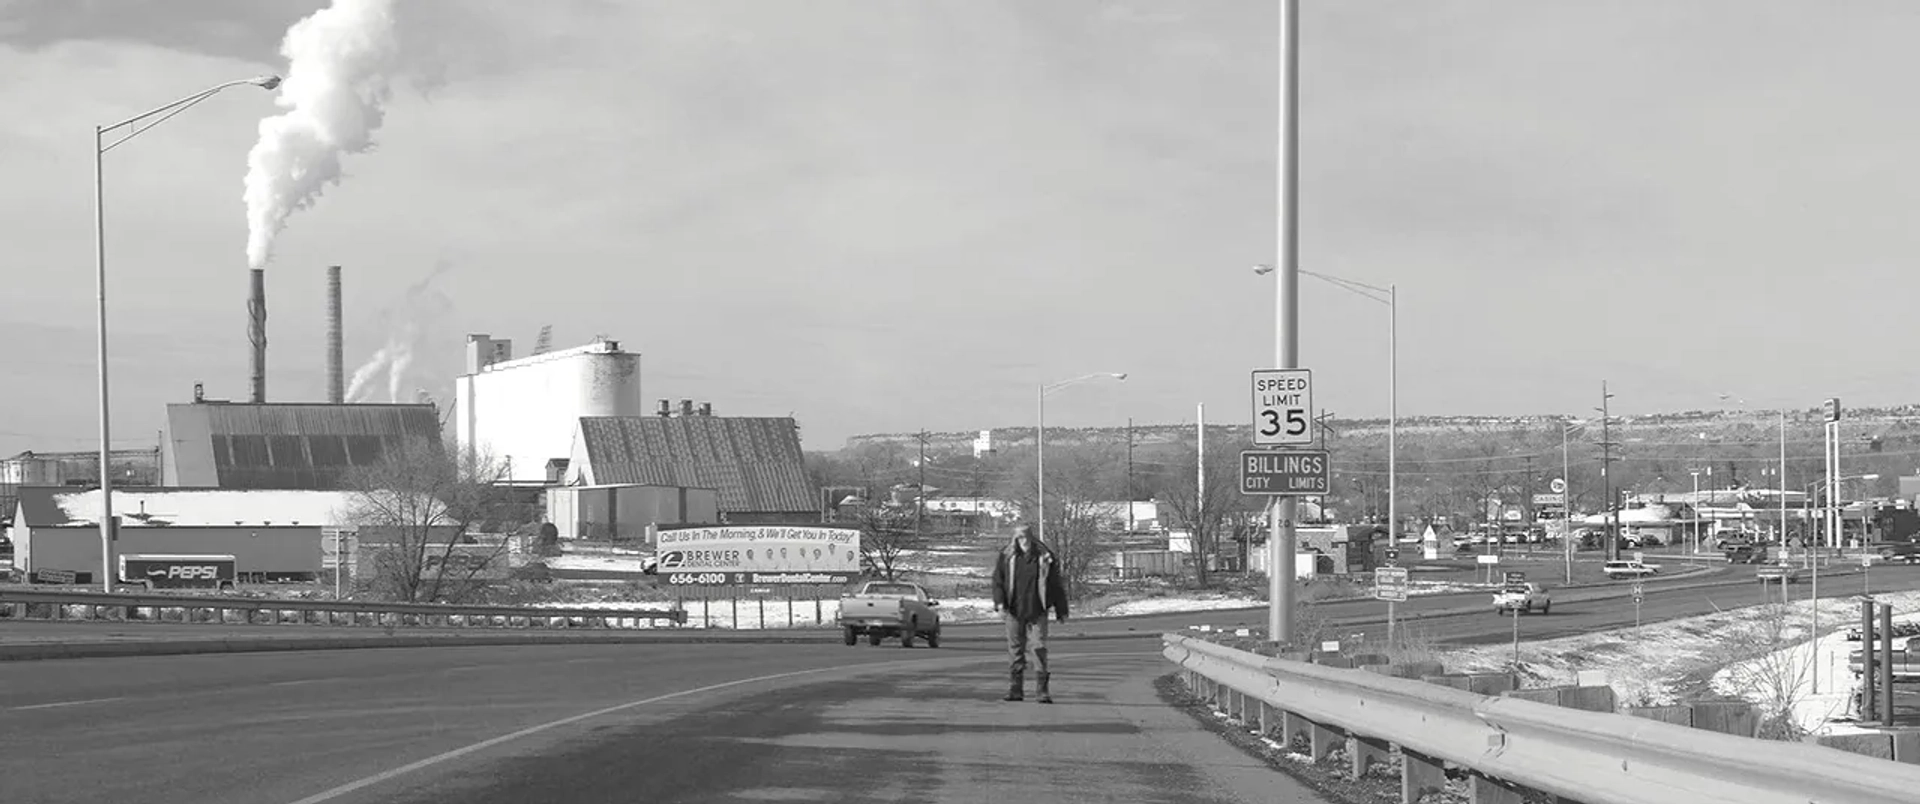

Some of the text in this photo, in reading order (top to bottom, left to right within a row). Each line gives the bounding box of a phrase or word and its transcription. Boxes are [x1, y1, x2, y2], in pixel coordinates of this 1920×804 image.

[1257, 378, 1307, 392] SPEED
[1263, 394, 1301, 407] LIMIT
[1260, 409, 1306, 436] 35
[1247, 456, 1323, 474] BILLINGS
[1246, 477, 1325, 489] CITY LIMITS
[660, 532, 677, 543] Call
[679, 531, 690, 541] Us
[692, 531, 700, 541] In
[702, 529, 718, 540] The
[757, 528, 765, 539] &
[787, 528, 802, 539] Get
[802, 529, 817, 540] You
[818, 530, 827, 540] In
[687, 550, 740, 561] BREWER
[168, 565, 218, 579] PEPSI
[669, 573, 848, 584] 656-6100 BrewerDentalCenter.com
